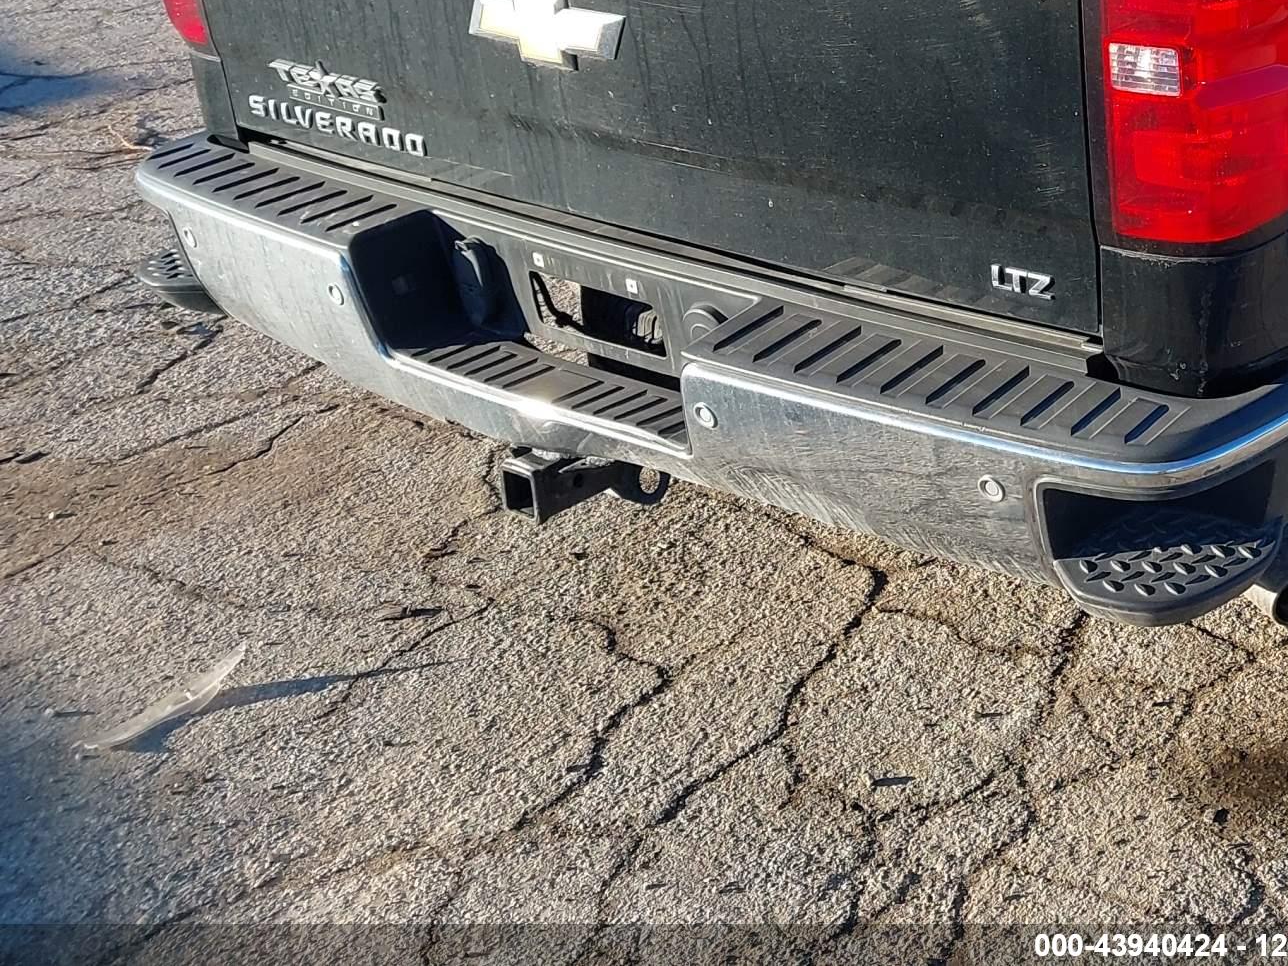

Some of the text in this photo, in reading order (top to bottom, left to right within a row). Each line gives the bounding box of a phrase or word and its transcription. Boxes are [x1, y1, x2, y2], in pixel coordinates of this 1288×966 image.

[268, 59, 386, 103] TEXAS
[290, 89, 375, 117] EDITION
[248, 94, 428, 157] SILVERADO
[991, 264, 1056, 300] LTZ
